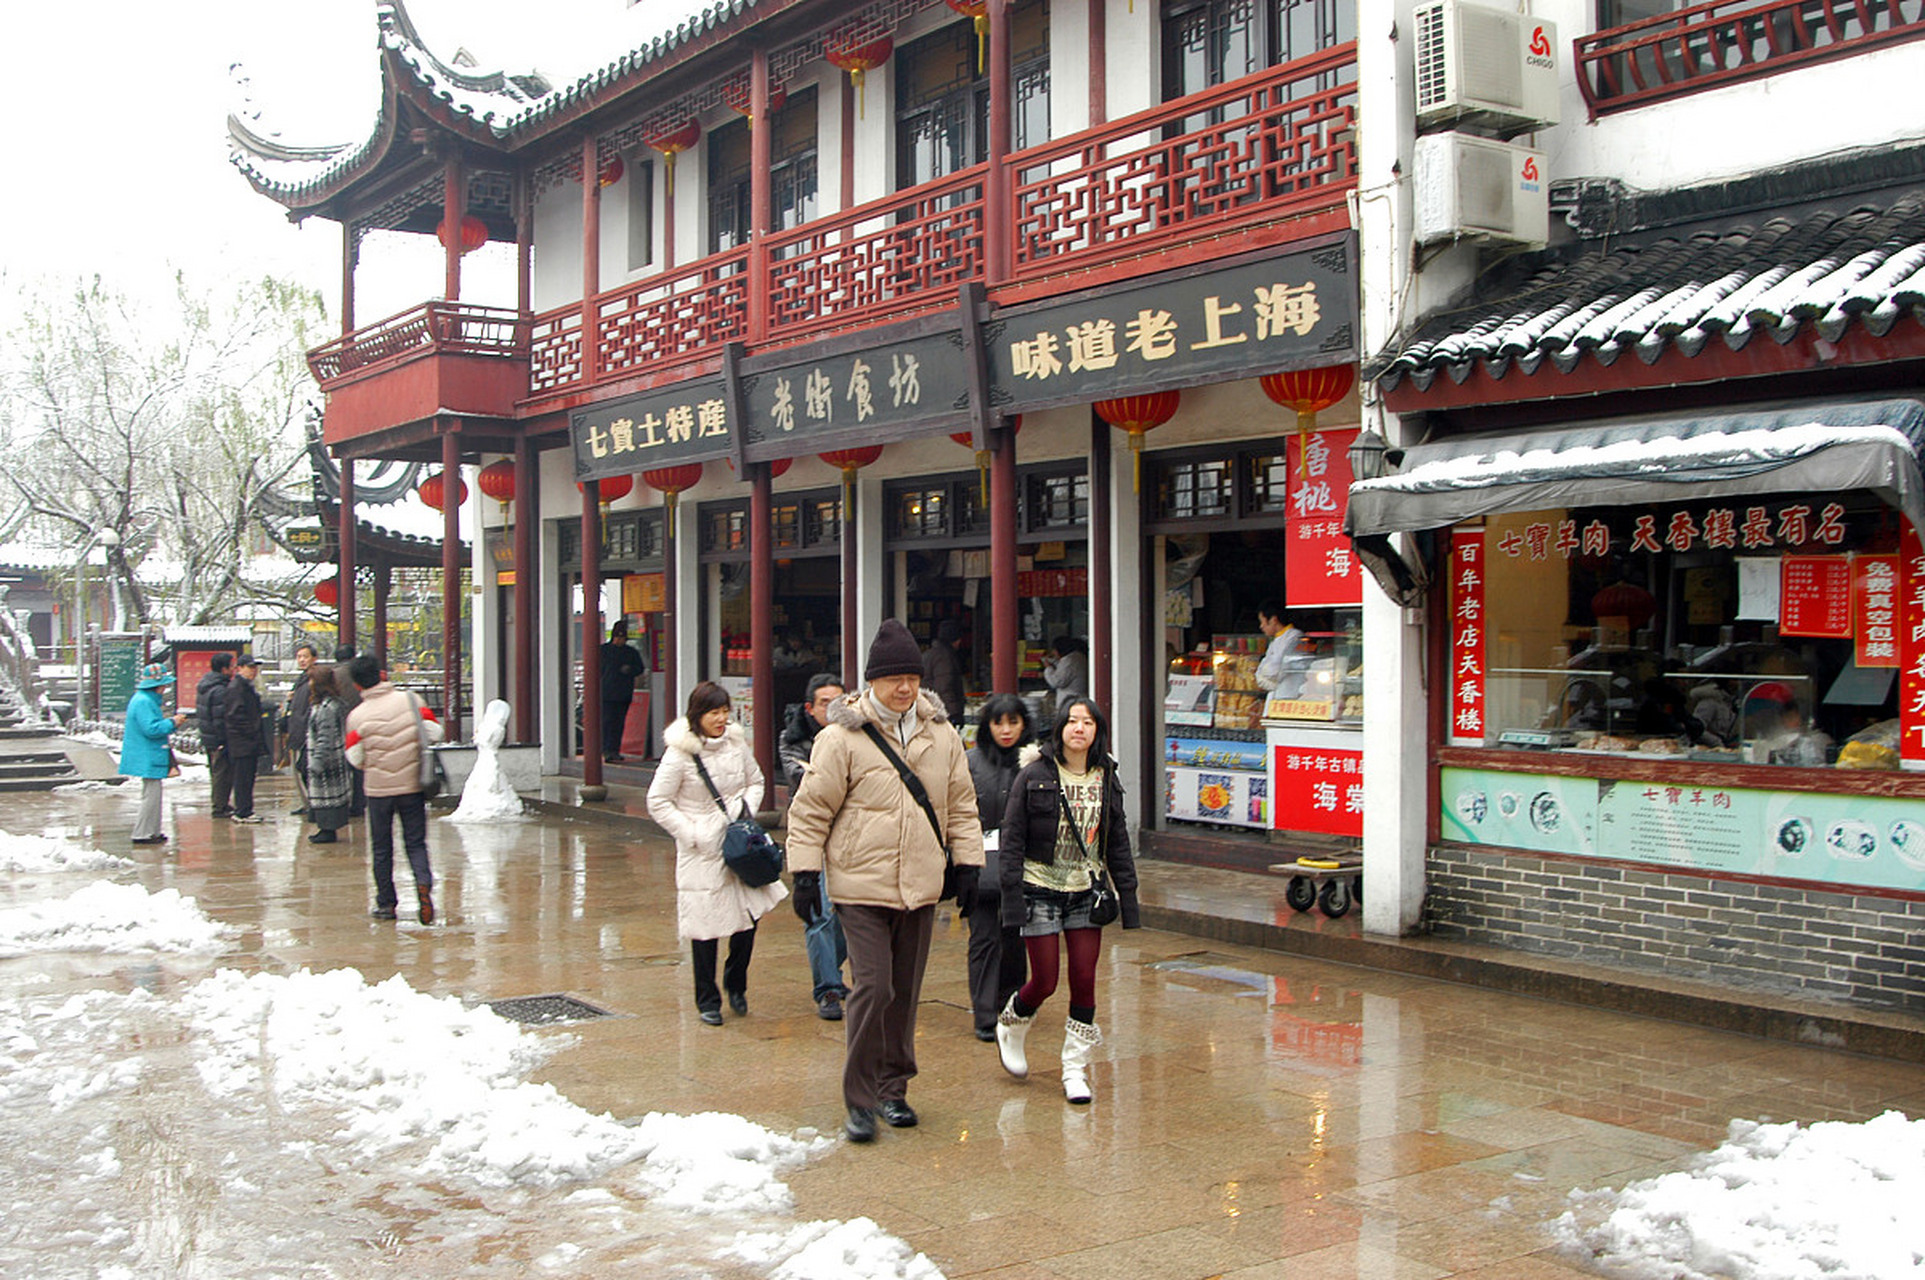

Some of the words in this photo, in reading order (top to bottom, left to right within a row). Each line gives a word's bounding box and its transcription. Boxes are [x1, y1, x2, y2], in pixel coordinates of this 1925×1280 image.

[1010, 281, 1322, 380] 味道老上海
[770, 354, 920, 431] 老街食坊
